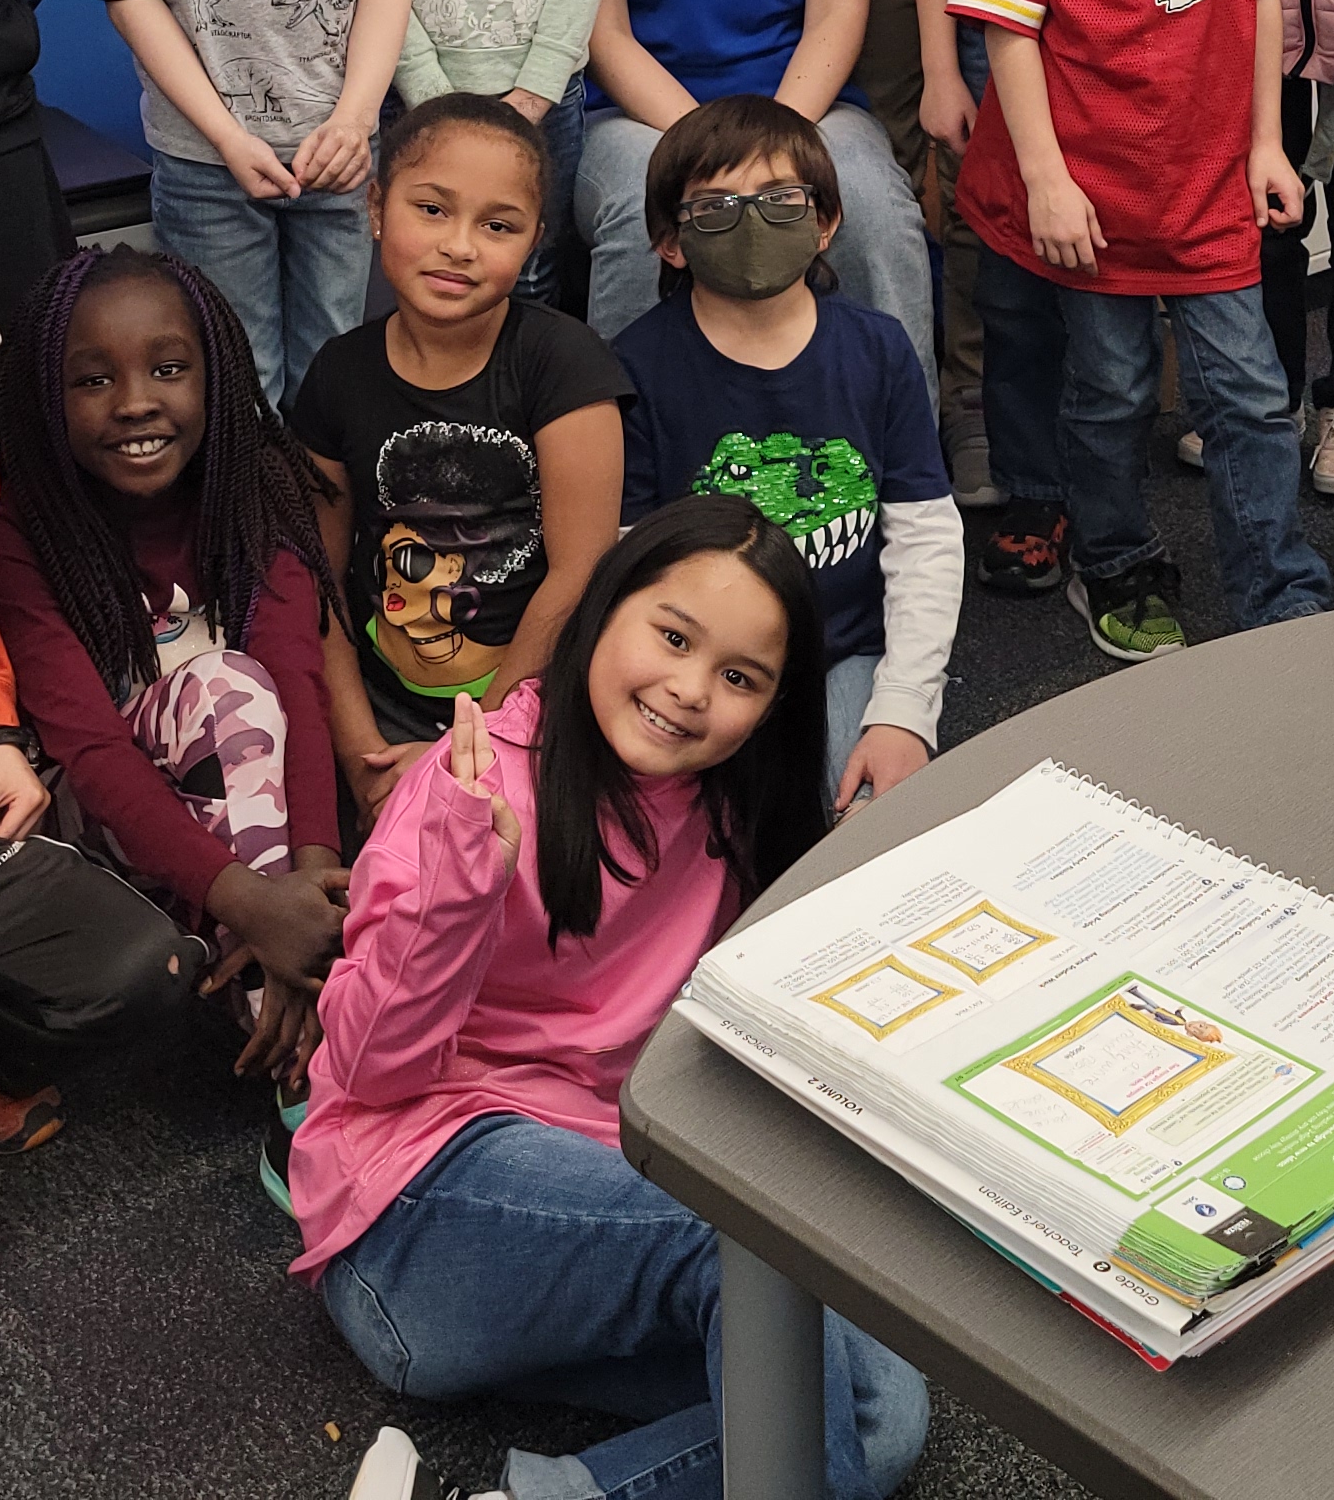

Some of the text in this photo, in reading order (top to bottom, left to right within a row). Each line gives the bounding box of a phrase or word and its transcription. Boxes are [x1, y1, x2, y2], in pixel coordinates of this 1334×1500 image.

[720, 1018, 778, 1059] TOPICS 9-15
[1064, 1045, 1086, 1060] people
[807, 1075, 865, 1116] VOLUME 2
[978, 1184, 1161, 1307] Grade 2 Teacher's Edition
